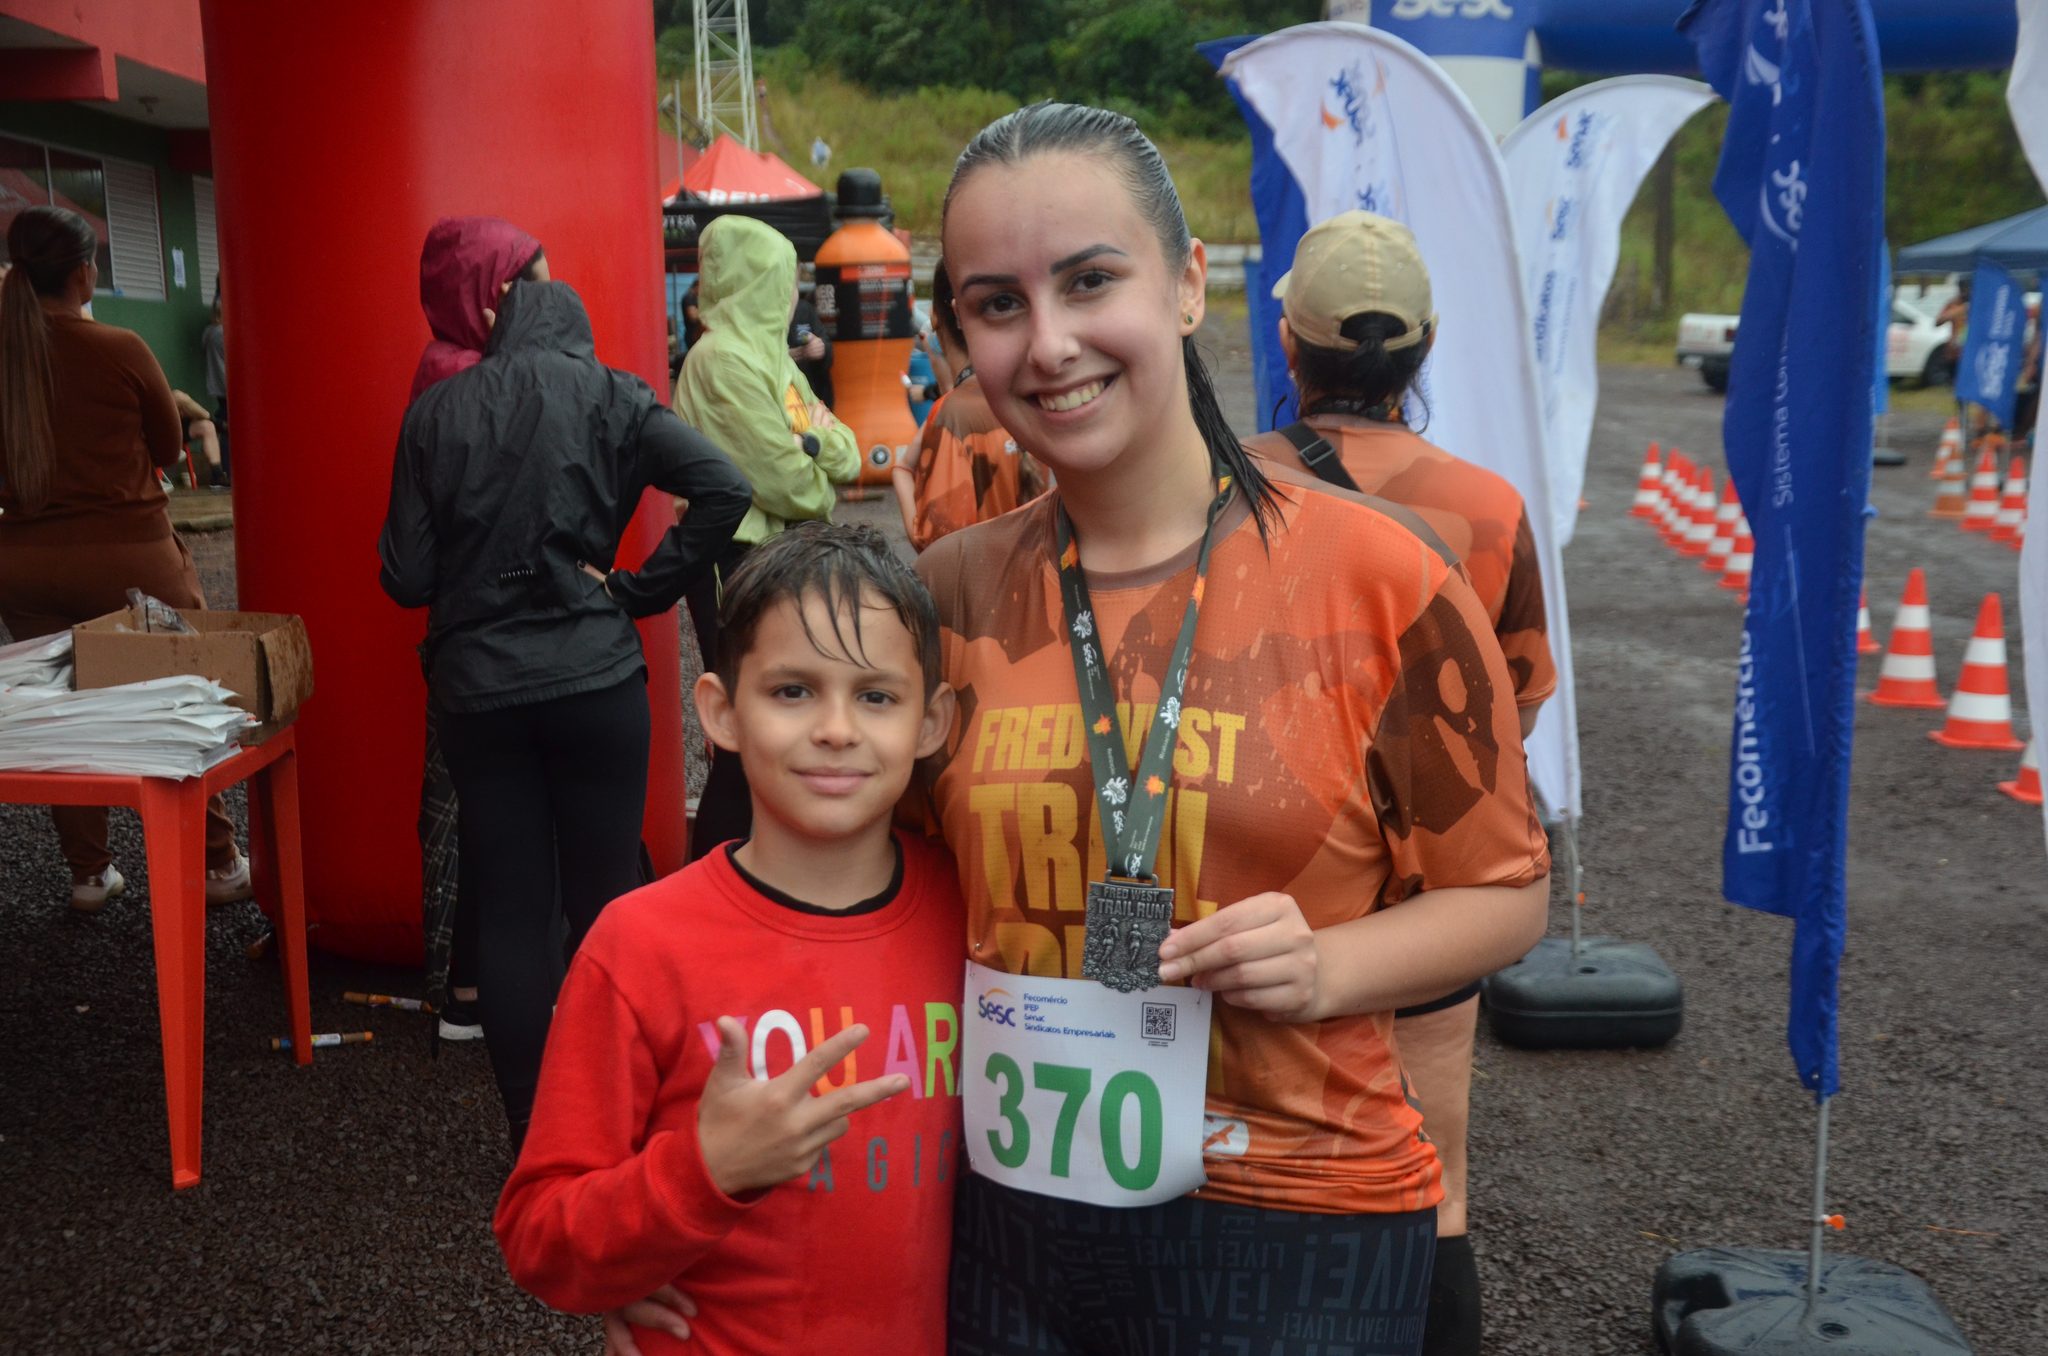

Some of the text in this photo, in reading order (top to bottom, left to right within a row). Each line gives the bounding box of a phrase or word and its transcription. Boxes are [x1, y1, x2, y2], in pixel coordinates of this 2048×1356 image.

[1772, 160, 1807, 233] esc
[973, 703, 1086, 774] FRED
[1096, 898, 1166, 919] TRAIL RUN
[1103, 886, 1160, 902] FRED WEST
[1023, 993, 1068, 1005] Fecomércio
[882, 1002, 962, 1099] AR
[1024, 1022, 1116, 1039] Sindicatos Empresariais
[985, 1052, 1163, 1191] 370
[807, 1130, 953, 1192] AGIC
[1150, 1268, 1271, 1323] LIVE!
[1297, 1222, 1432, 1311] LIVE!
